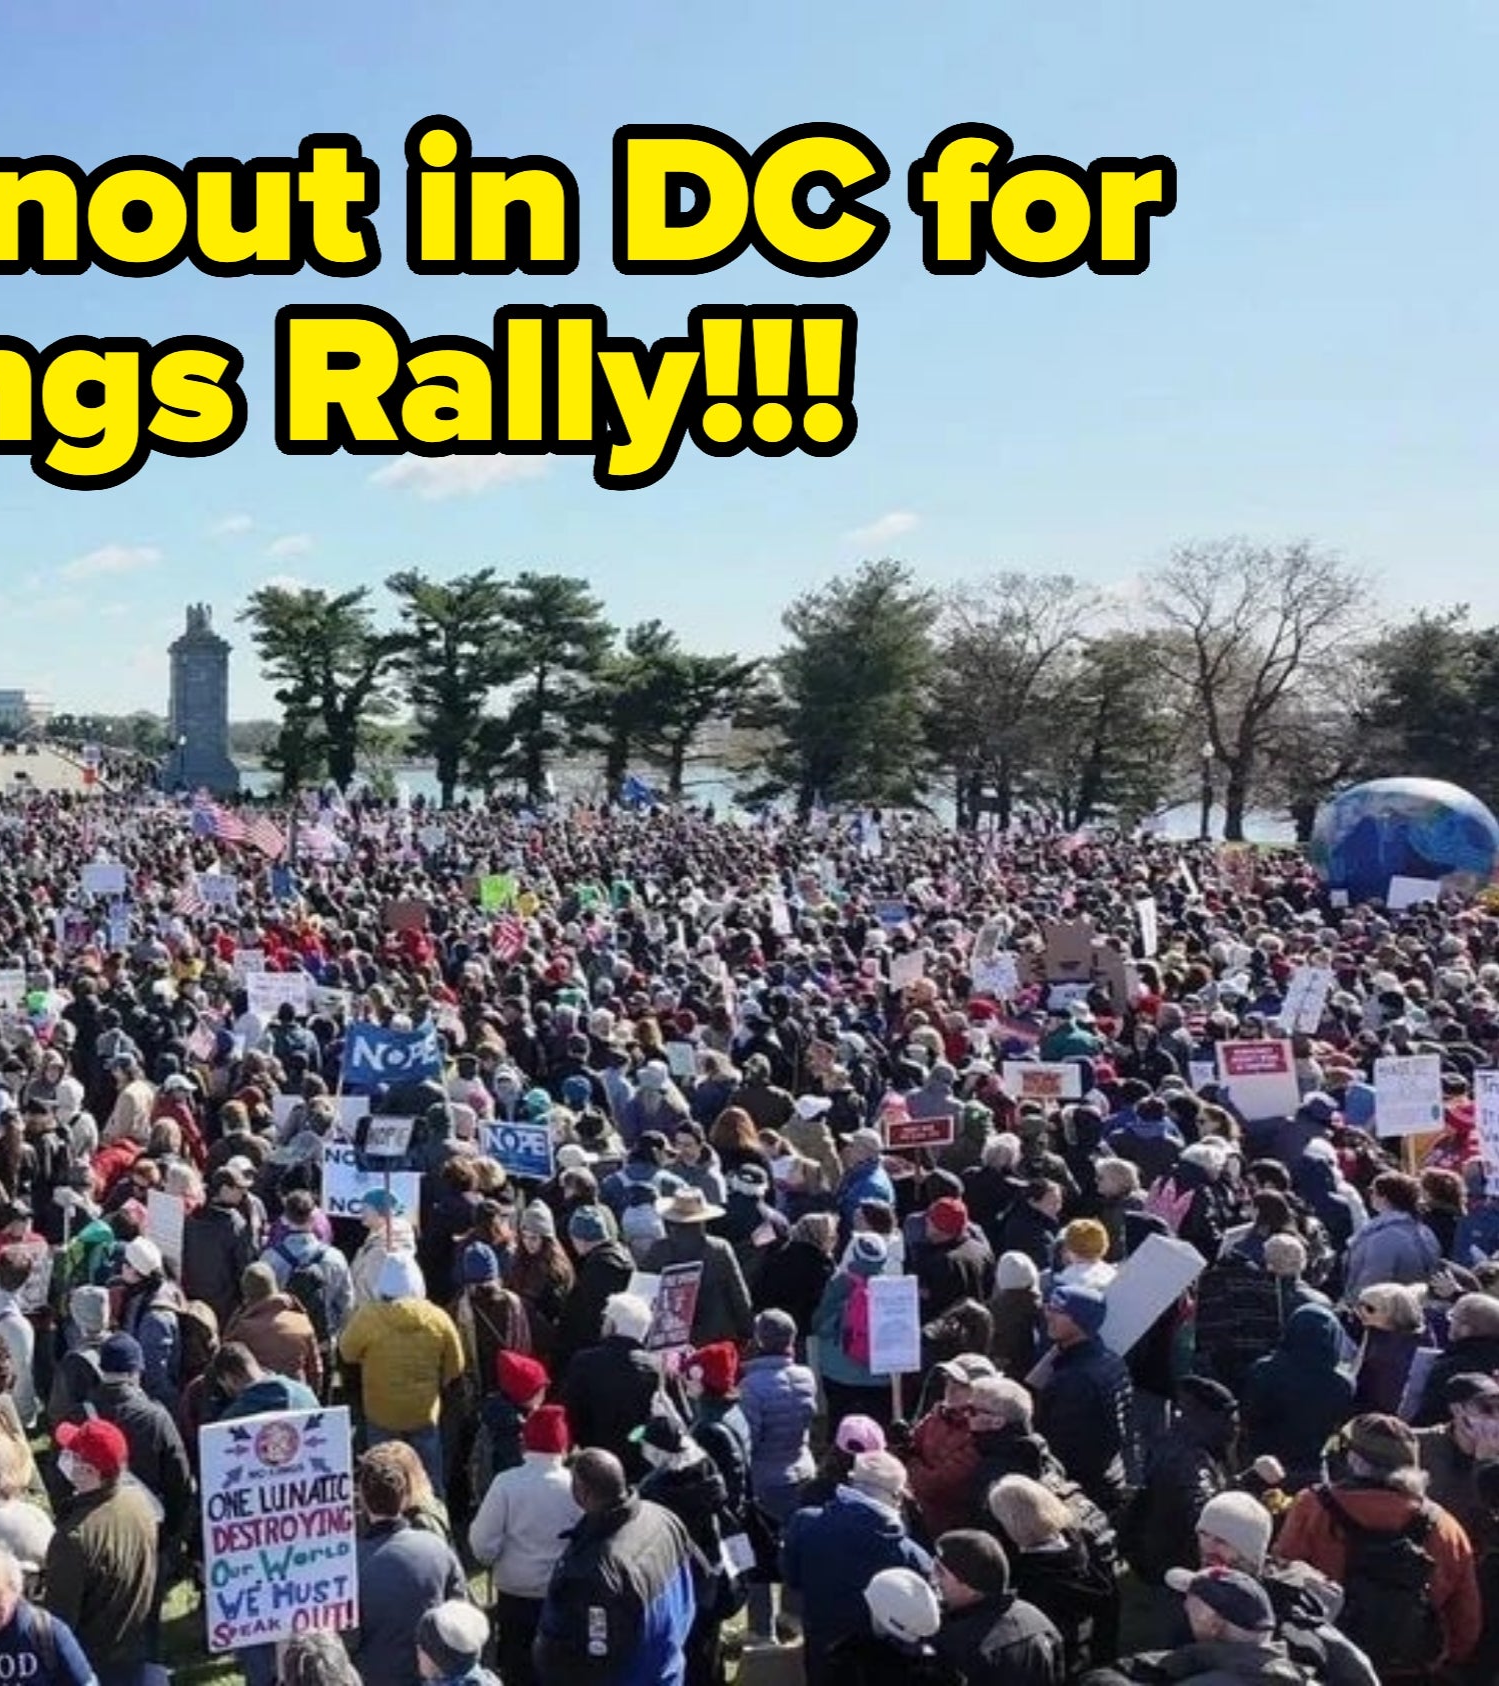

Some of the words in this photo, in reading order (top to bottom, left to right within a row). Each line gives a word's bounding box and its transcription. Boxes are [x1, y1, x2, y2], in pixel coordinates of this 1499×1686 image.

[352, 1033, 438, 1071] NOPE
[486, 1127, 545, 1156] NOPE
[208, 1488, 252, 1522] ONE
[259, 1474, 350, 1514] LUNATIC
[211, 1505, 352, 1555] DESTROYING
[217, 1583, 260, 1620] WE
[272, 1575, 349, 1610] MUST
[292, 1599, 354, 1634] OUT!
